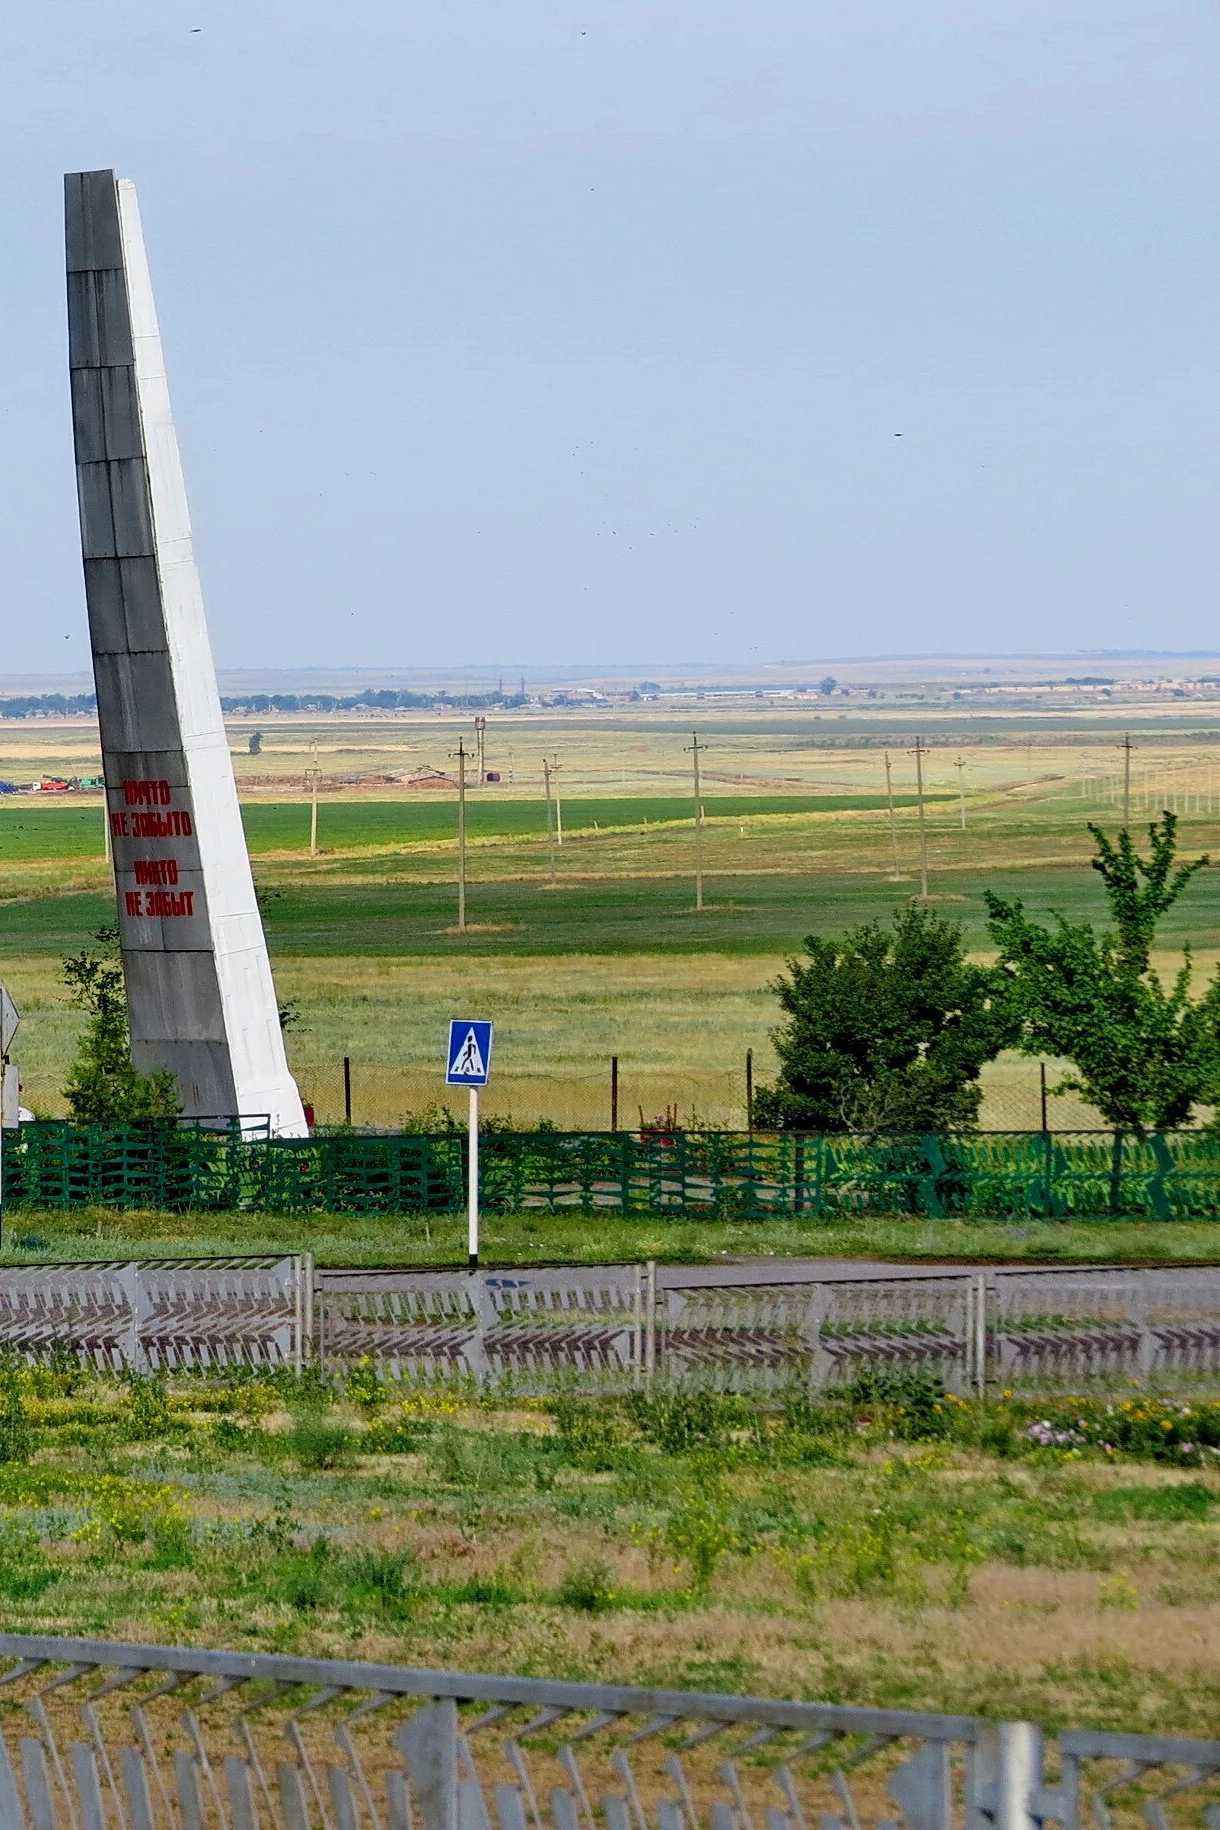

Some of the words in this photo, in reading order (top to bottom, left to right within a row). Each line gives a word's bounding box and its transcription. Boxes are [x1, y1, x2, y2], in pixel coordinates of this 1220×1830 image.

[123, 780, 171, 805] НИЧТО
[112, 813, 129, 837] НЕ
[131, 811, 192, 837] ЗАБЫТО
[134, 860, 178, 885] НИКТО
[125, 892, 142, 916] НЕ
[146, 891, 194, 916] ЗАБЫТ
